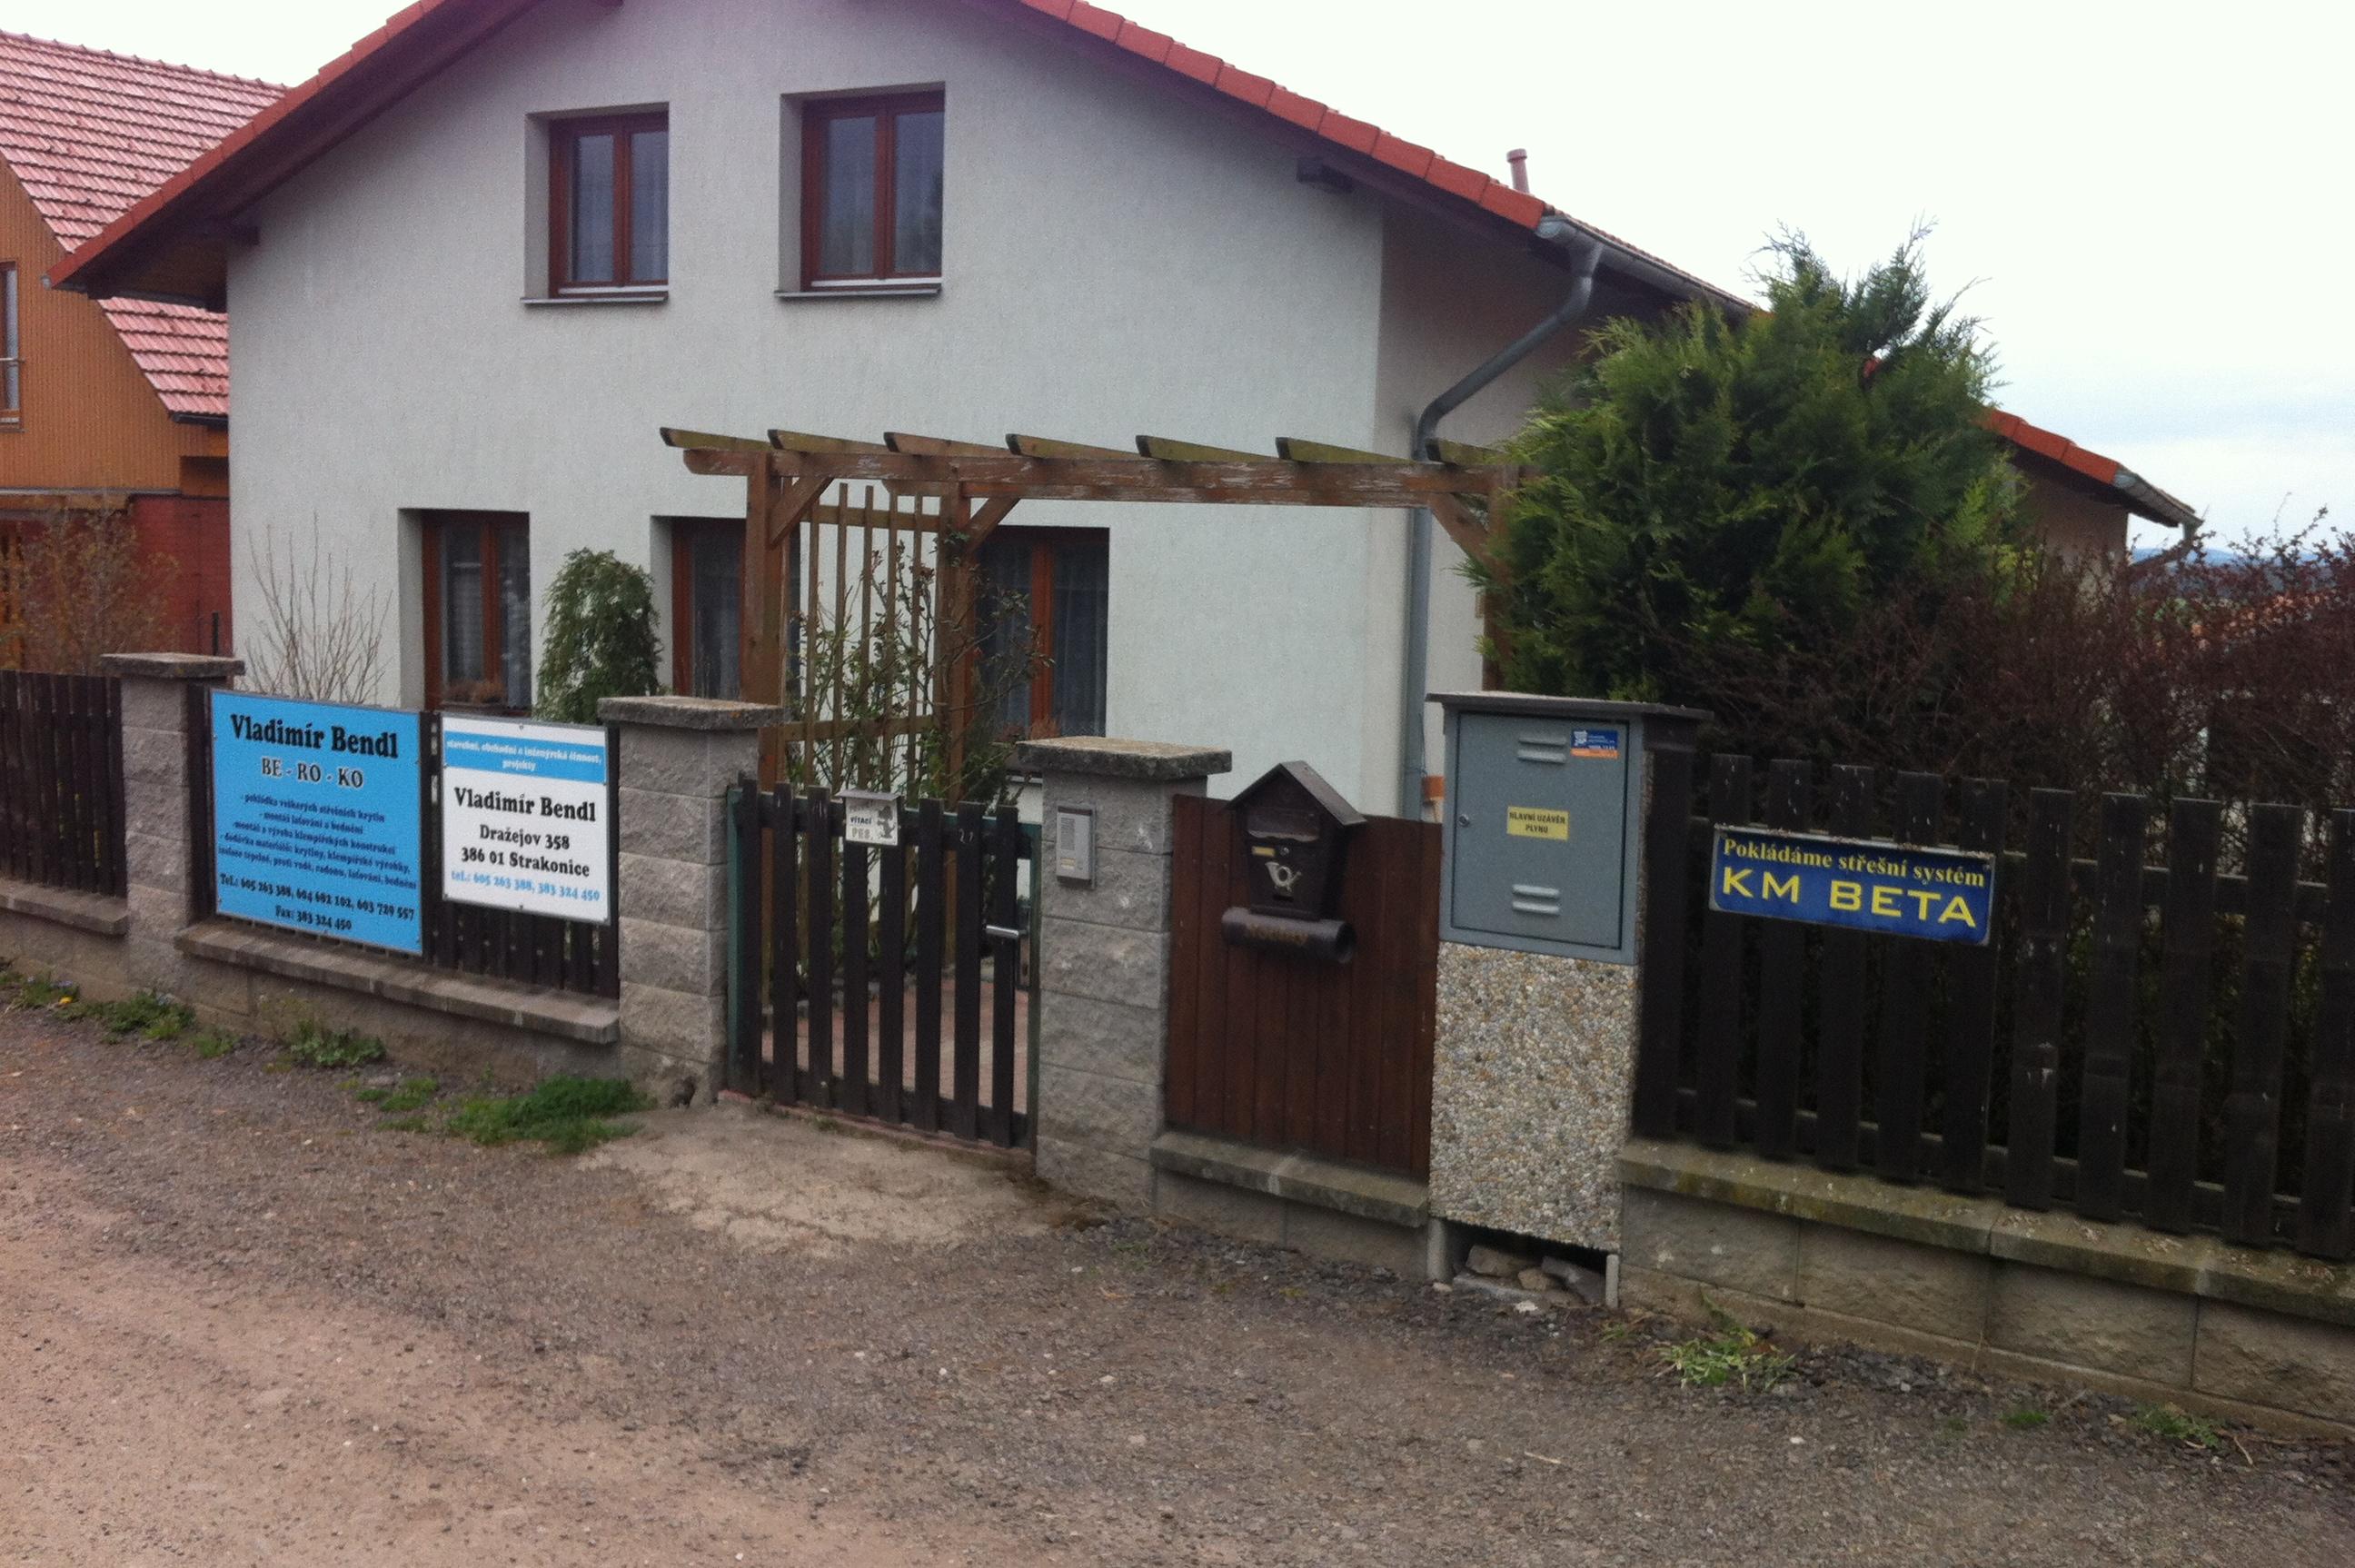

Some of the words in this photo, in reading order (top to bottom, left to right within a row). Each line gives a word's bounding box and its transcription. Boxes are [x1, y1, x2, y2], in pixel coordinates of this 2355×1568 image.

[231, 713, 324, 749] Vladimír
[331, 725, 399, 759] Bendl
[262, 757, 283, 778] BE
[297, 762, 322, 783] RO
[337, 767, 363, 789] KO
[454, 786, 535, 815] Vladimír
[540, 797, 596, 822] Bendl
[479, 824, 542, 848] Dražejov
[545, 833, 571, 850] 358
[462, 846, 486, 863] 386
[489, 850, 505, 866] 01
[509, 851, 591, 878] Strakonice
[1723, 838, 1833, 869] Pokládáme
[1838, 852, 1908, 878] střešní
[1913, 865, 1985, 888] systém
[241, 878, 256, 891] 605
[259, 881, 273, 895] 263
[473, 873, 492, 887] 605
[493, 876, 512, 889] 263
[559, 885, 579, 899] 324
[581, 888, 601, 902] 450
[1723, 866, 1801, 904] KM
[1829, 879, 1977, 928] BETA
